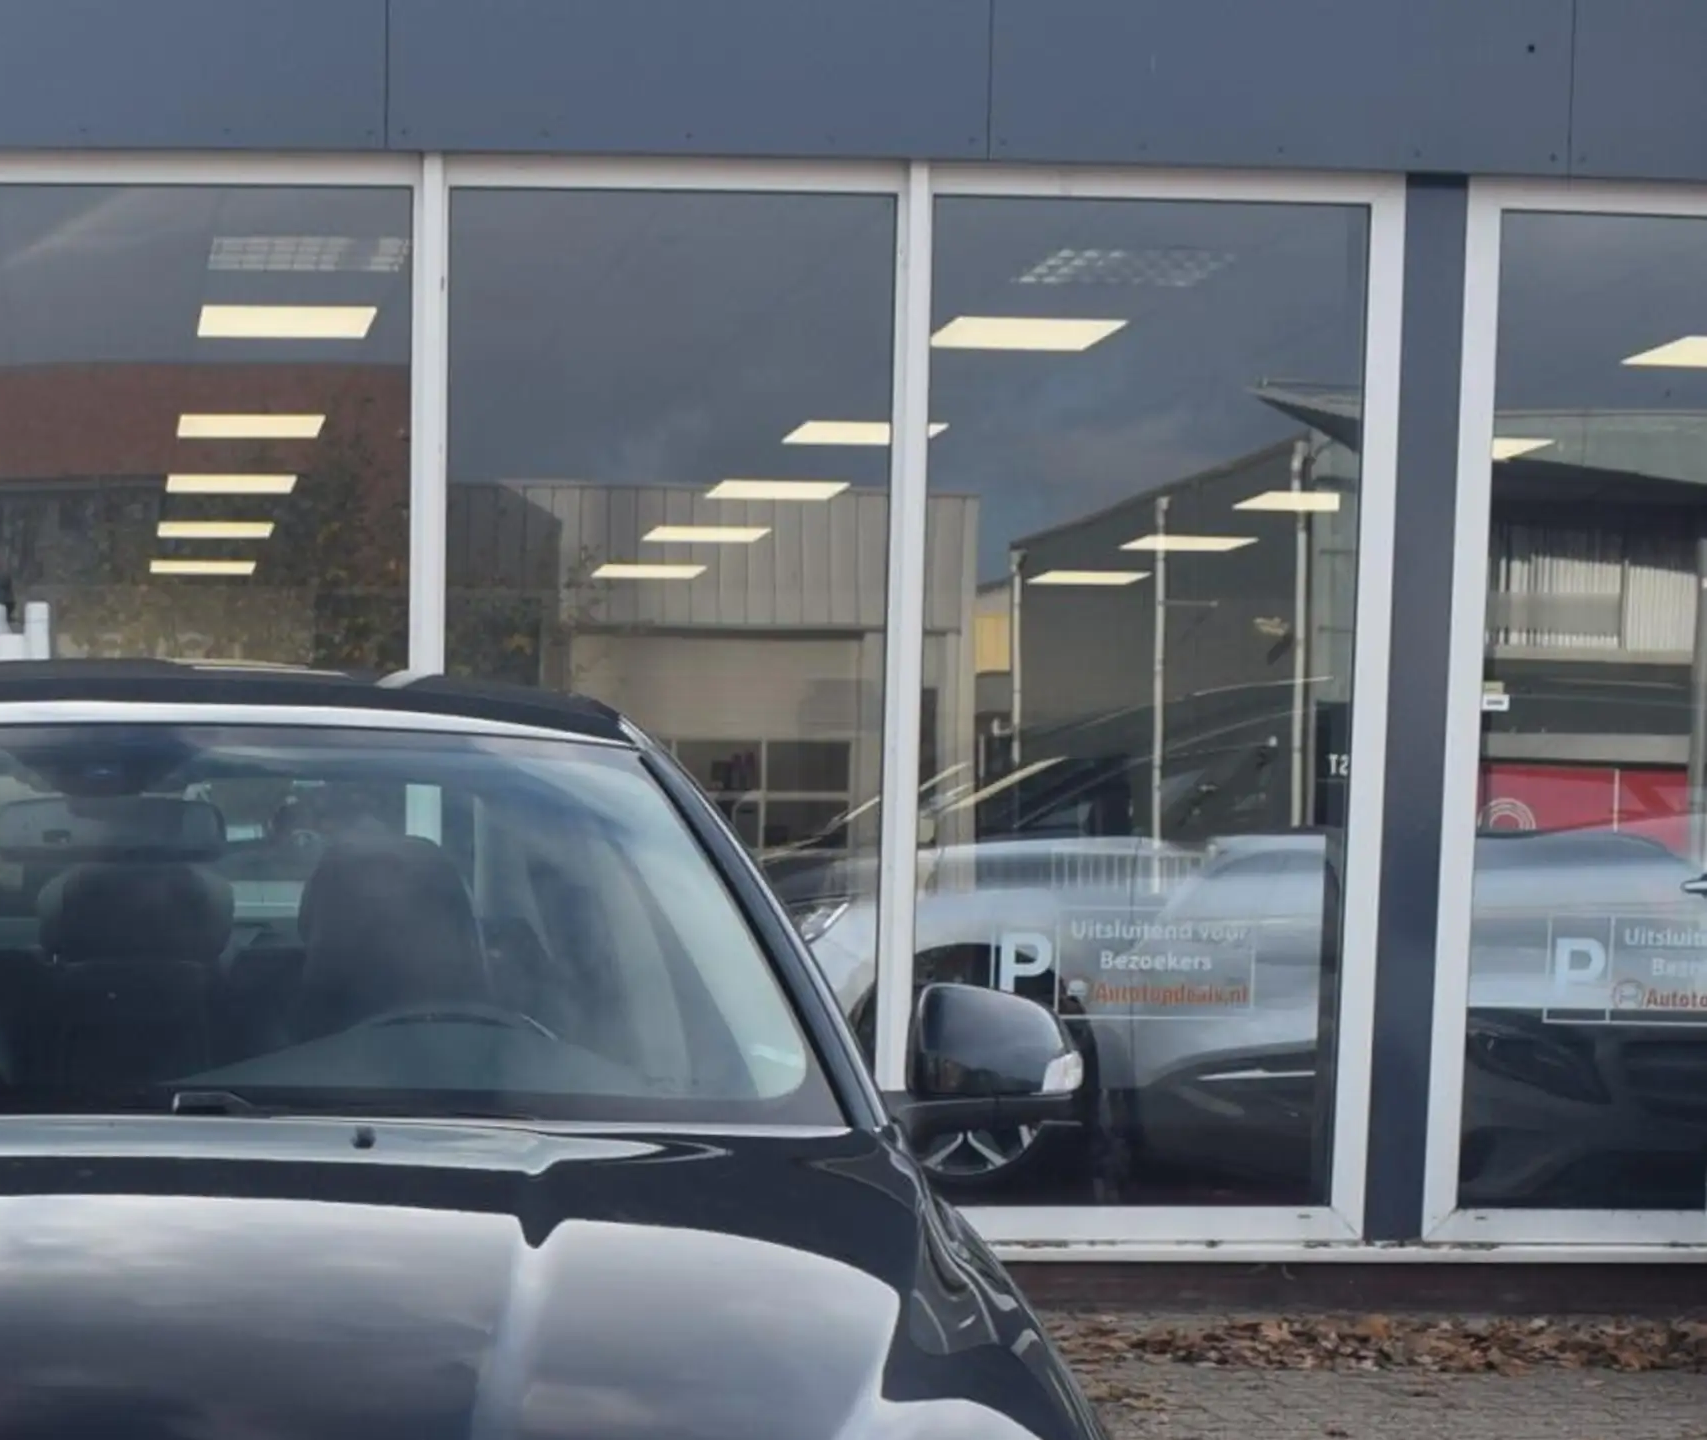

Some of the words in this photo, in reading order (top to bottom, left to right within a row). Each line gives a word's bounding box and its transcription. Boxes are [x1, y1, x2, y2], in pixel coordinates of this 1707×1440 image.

[1070, 918, 1193, 941] Uitsluitend
[999, 932, 1052, 993] P
[1100, 949, 1213, 971] Bezoekers
[1555, 936, 1607, 998] P
